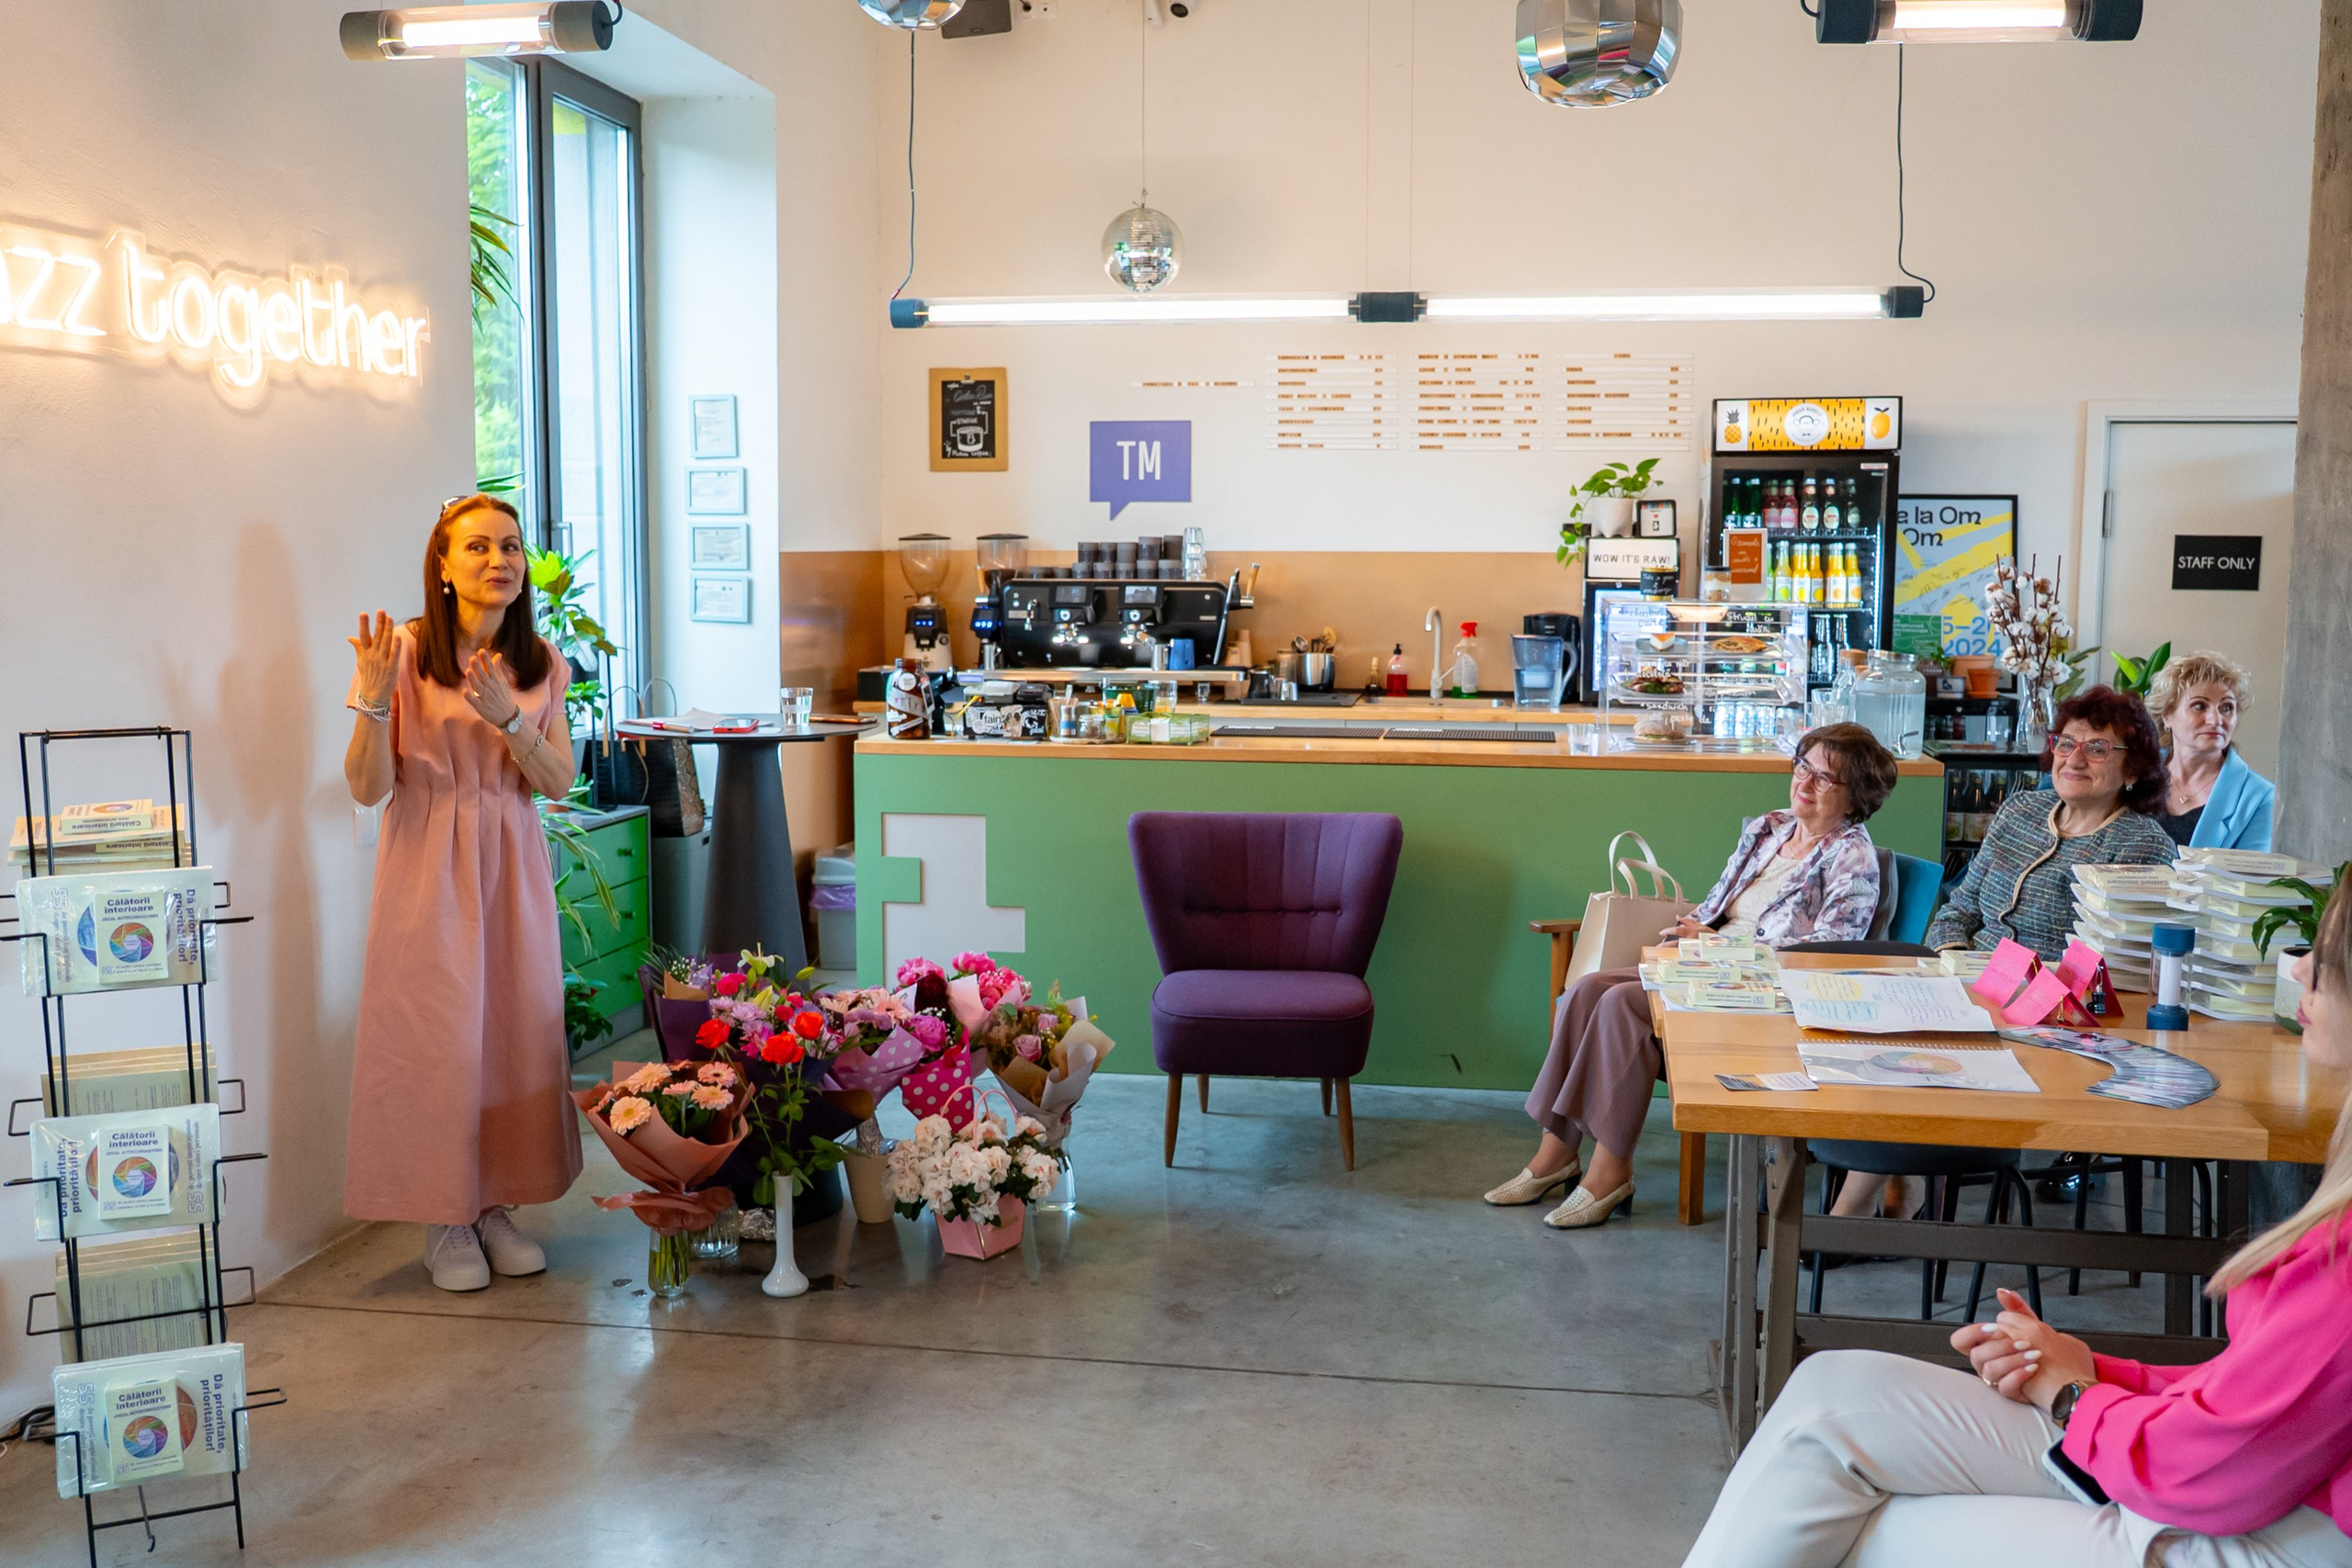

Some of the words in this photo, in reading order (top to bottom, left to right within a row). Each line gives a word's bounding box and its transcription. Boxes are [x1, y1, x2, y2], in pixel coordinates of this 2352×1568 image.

[0, 246, 107, 336] zz
[122, 242, 426, 387] together
[1116, 441, 1160, 480] TM
[1915, 506, 1933, 525] la
[1939, 506, 1981, 525] Om
[1903, 528, 1943, 547] Om
[1593, 554, 1619, 562] WOW
[1623, 554, 1640, 563] IT'S
[1644, 555, 1670, 564] RAW!
[2177, 556, 2214, 570] STAFF
[2217, 557, 2256, 570] ONLY
[1943, 638, 2002, 657] 2024
[51, 888, 70, 909] 55
[107, 897, 150, 907] Călătorii
[105, 905, 153, 914] interioare
[109, 1139, 158, 1148] interioare
[112, 1131, 155, 1140] Călătorii
[187, 1191, 204, 1213] 55
[213, 1374, 223, 1390] Dă
[77, 1383, 96, 1405] 55
[116, 1396, 165, 1410] interioare
[213, 1393, 227, 1454] prioritate,
